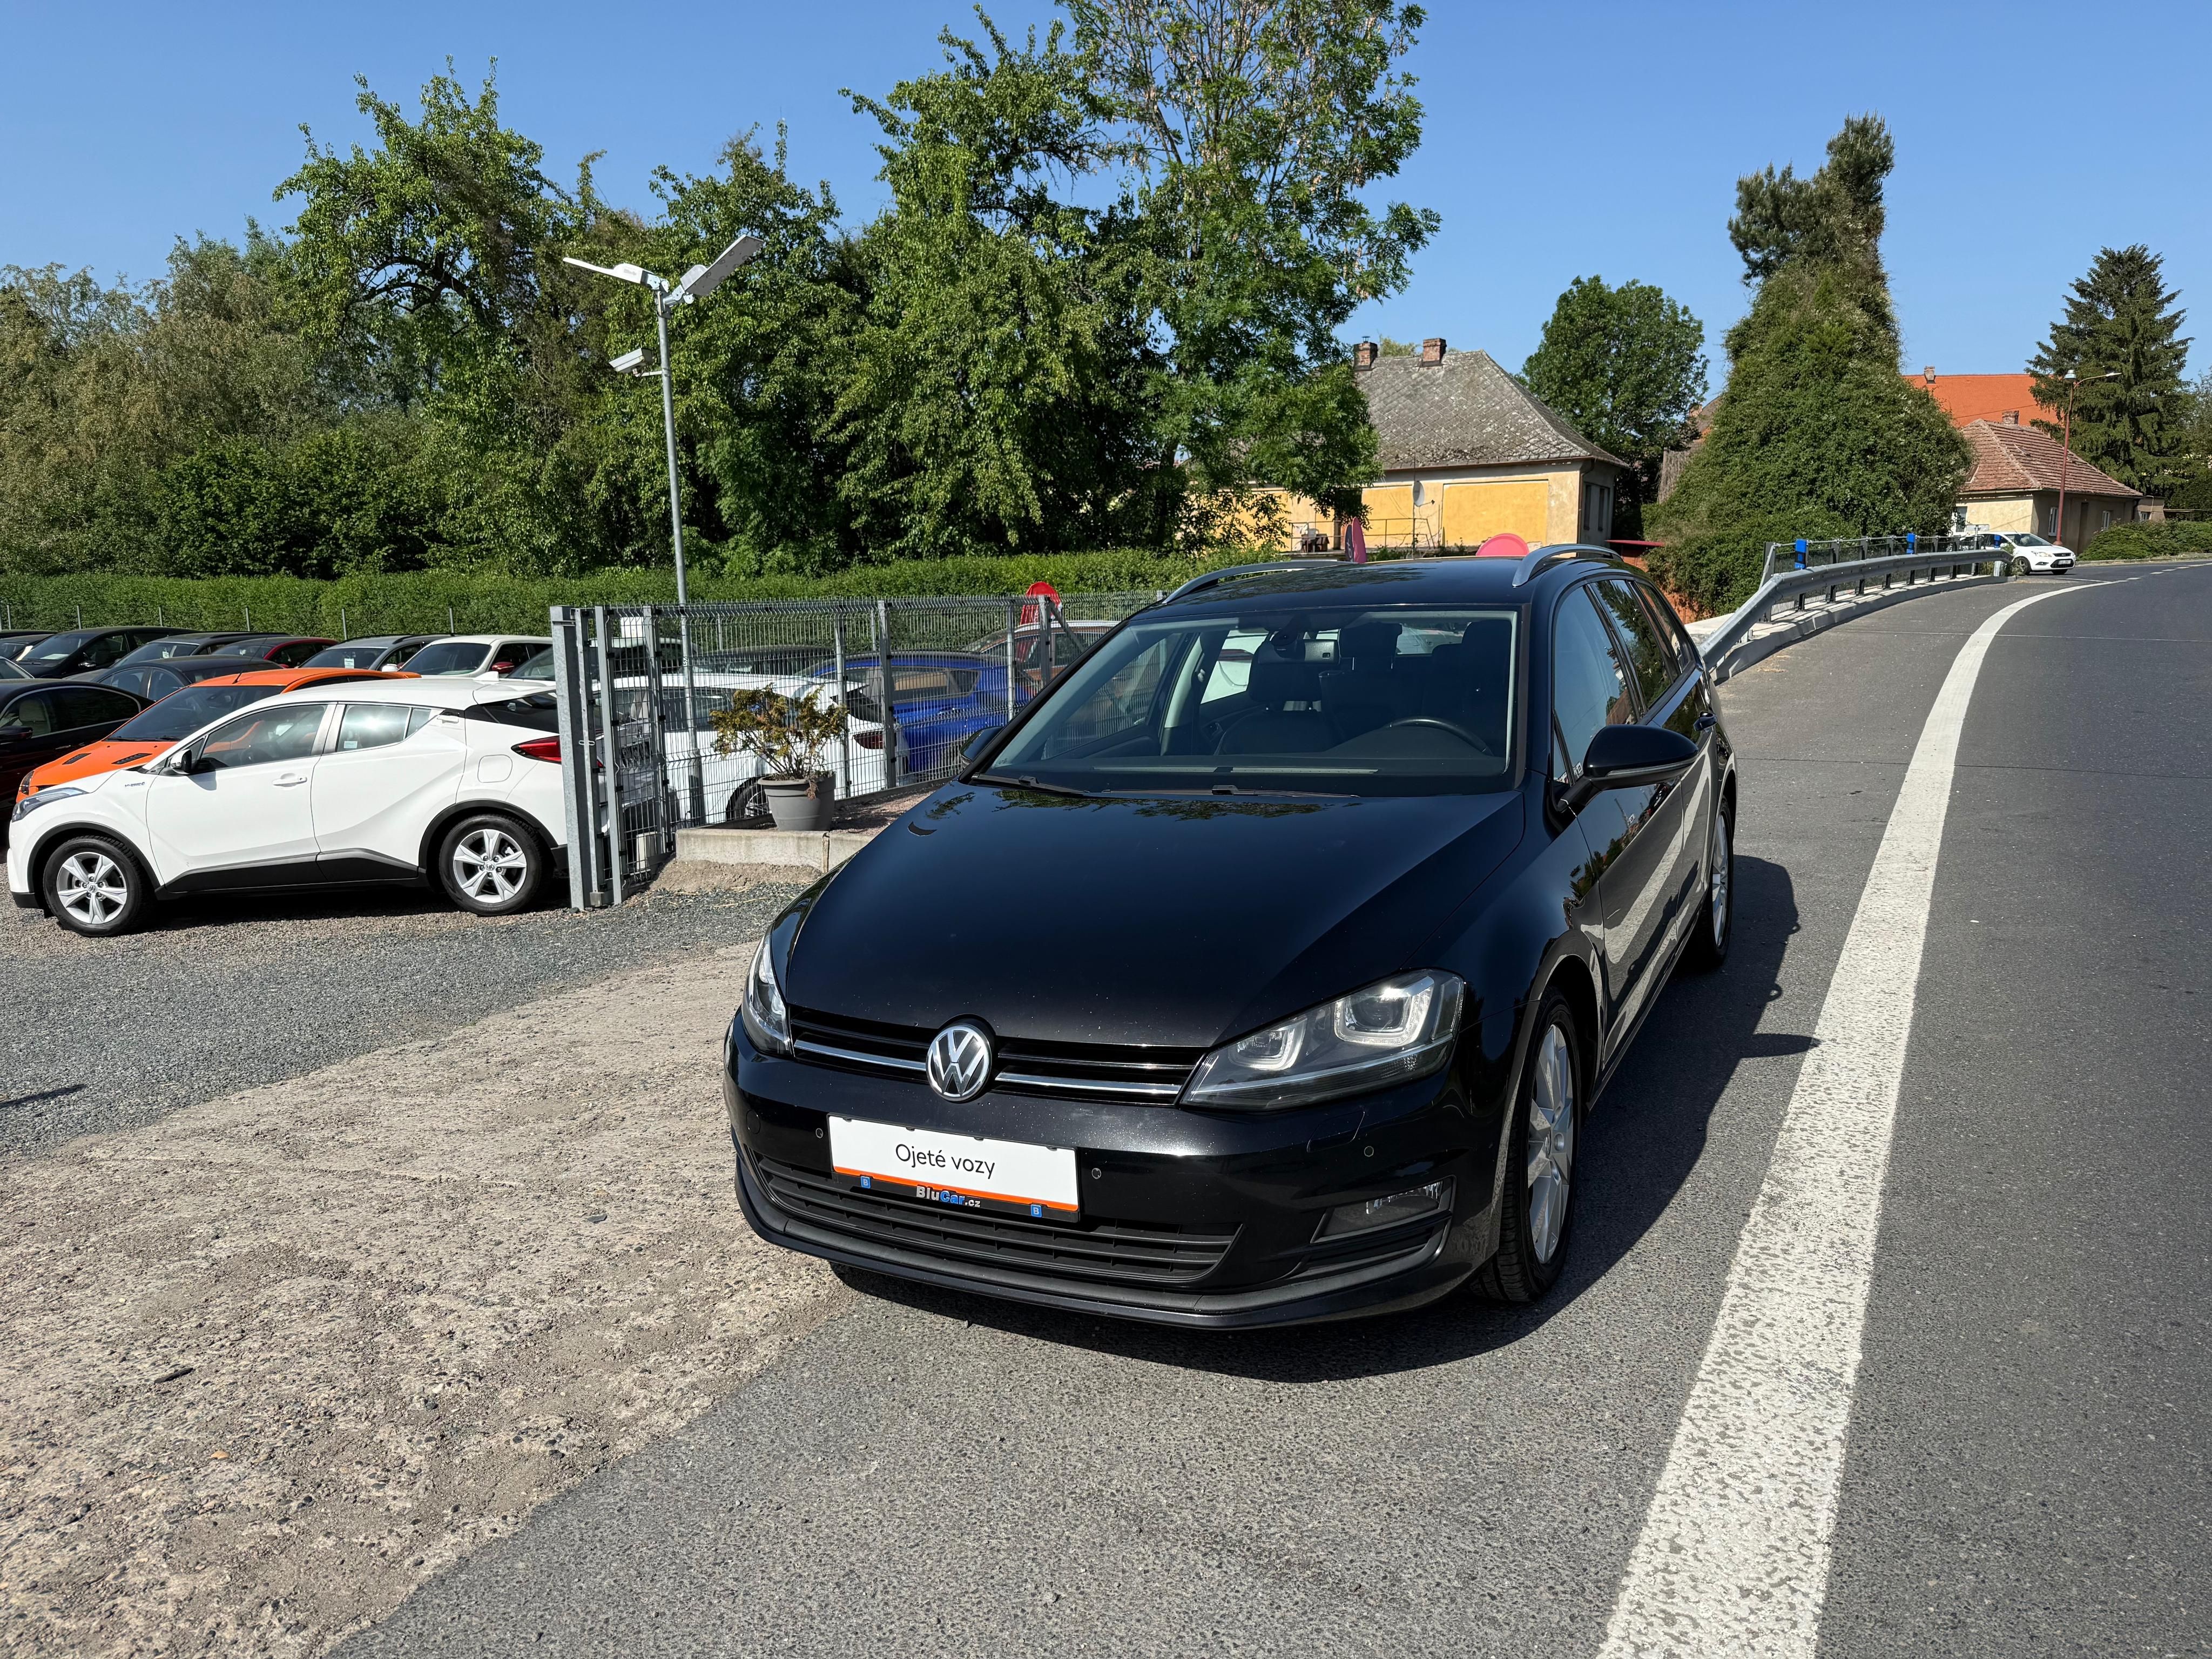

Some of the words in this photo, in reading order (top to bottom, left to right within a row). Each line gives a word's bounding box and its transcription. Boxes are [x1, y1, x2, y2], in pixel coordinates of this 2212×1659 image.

[927, 1026, 991, 1101] VW
[895, 1143, 946, 1168] Ojeté
[951, 1156, 995, 1179] vozy
[862, 1178, 869, 1186] B
[916, 1185, 981, 1208] BluCar.cz
[1033, 1206, 1040, 1215] B
